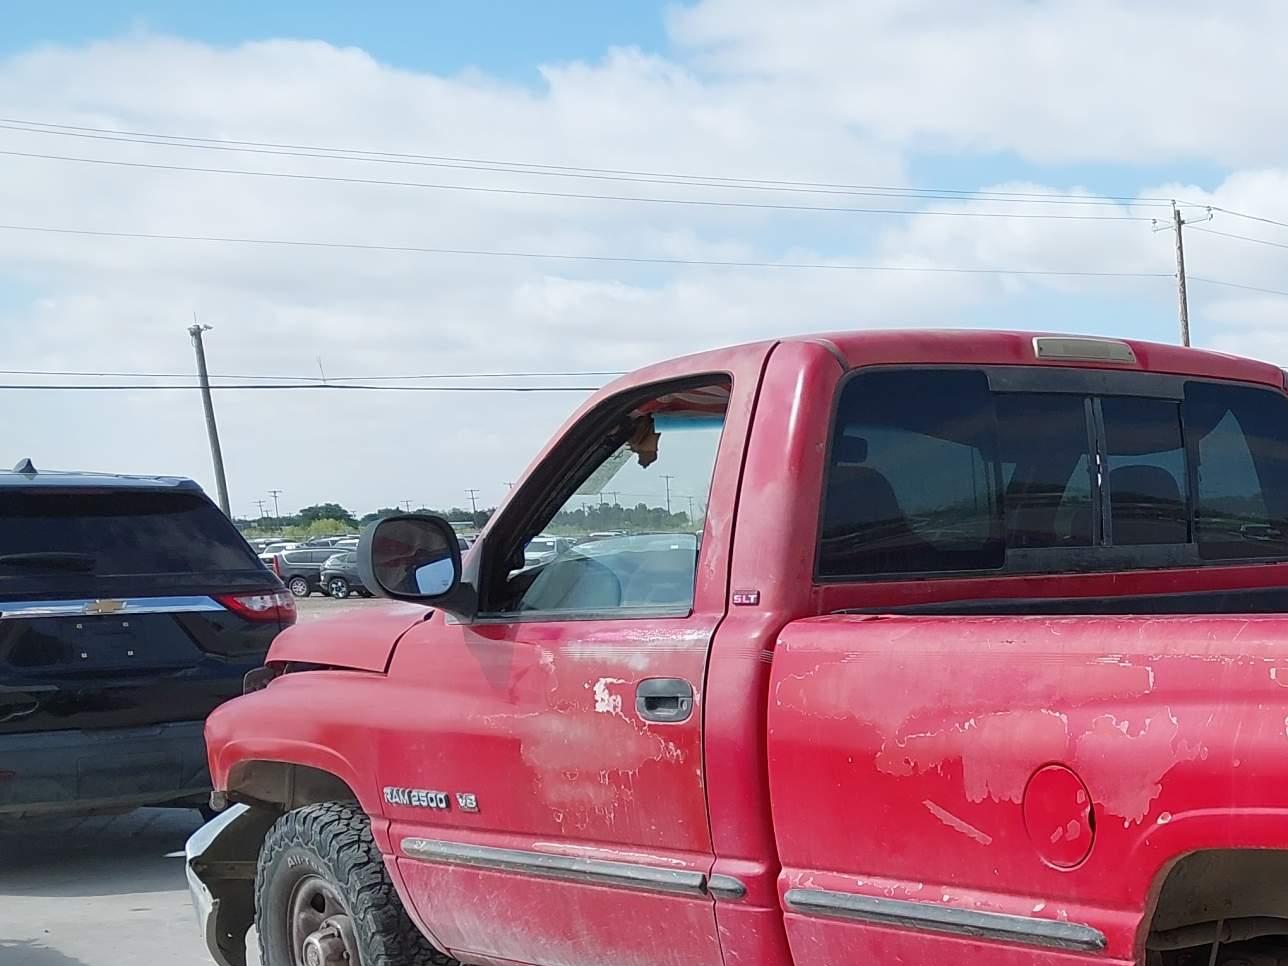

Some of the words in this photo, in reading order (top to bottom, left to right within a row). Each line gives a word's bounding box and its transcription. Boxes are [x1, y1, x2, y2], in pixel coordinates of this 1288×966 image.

[733, 594, 758, 604] SLT
[383, 786, 412, 806] RAM
[410, 789, 448, 809] 2500
[455, 792, 478, 811] V8
